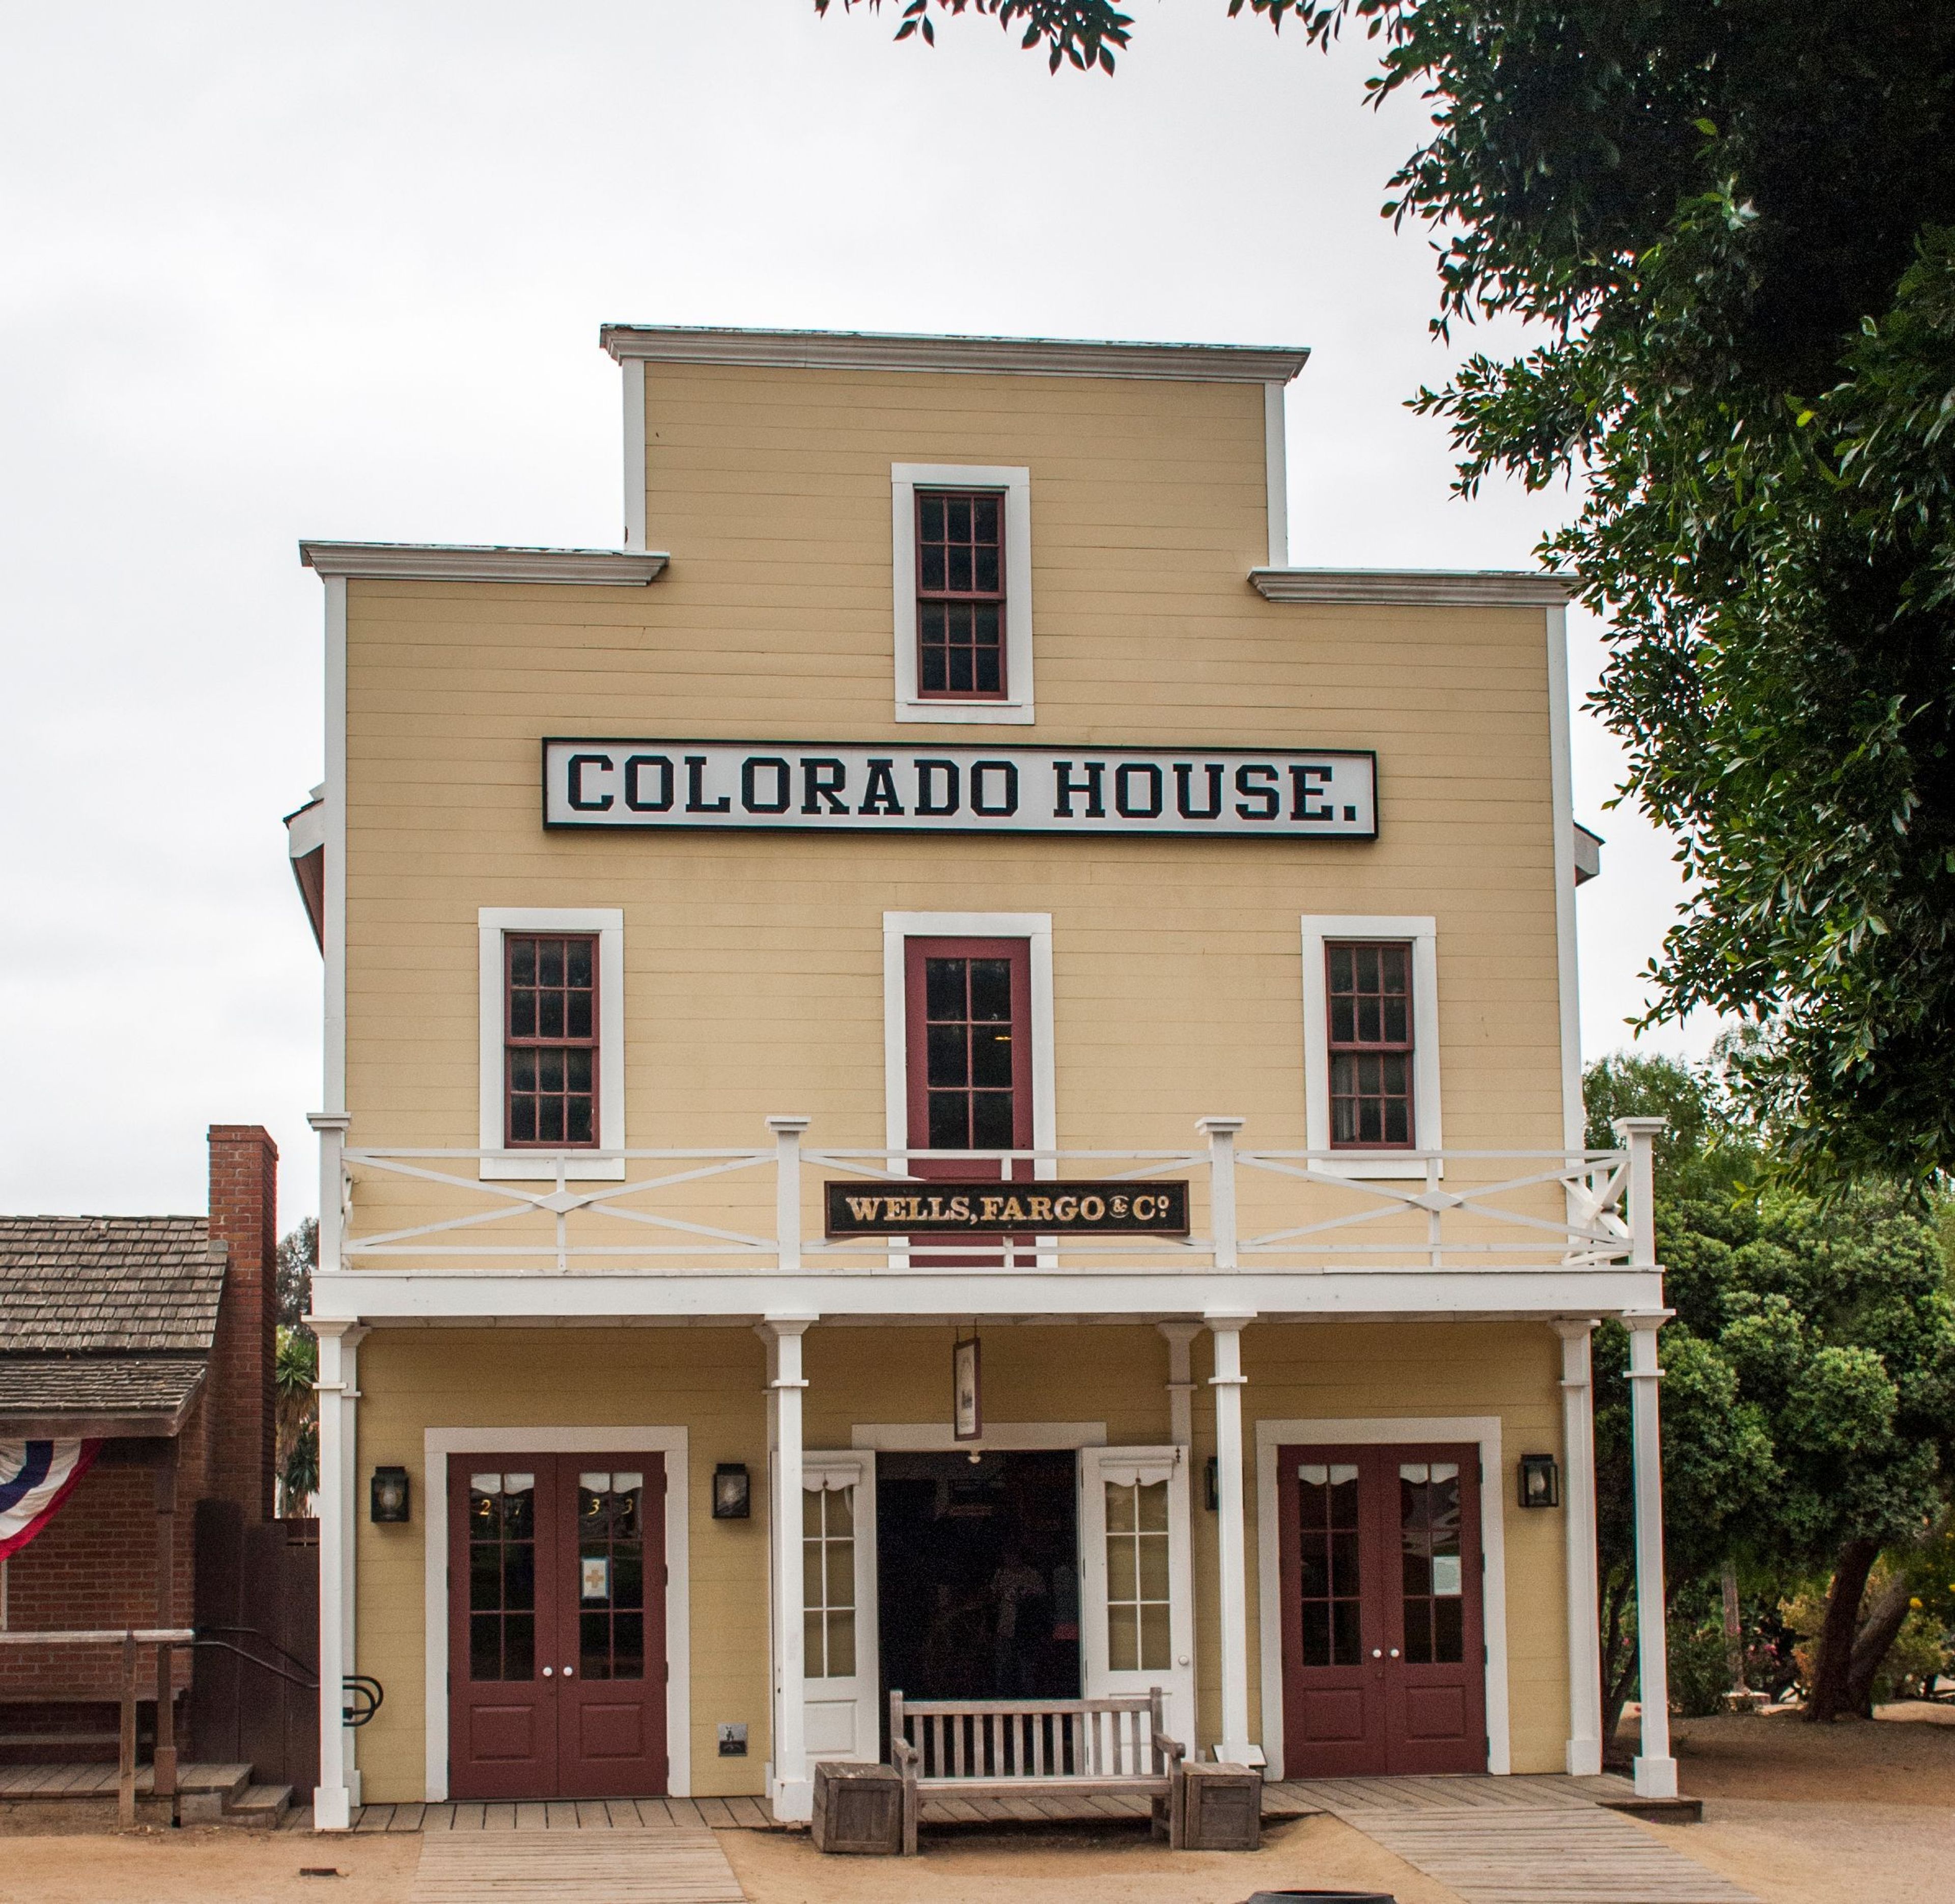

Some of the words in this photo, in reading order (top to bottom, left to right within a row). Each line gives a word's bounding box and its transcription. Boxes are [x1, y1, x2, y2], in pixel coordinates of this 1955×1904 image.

[567, 754, 1018, 817] COLORADO
[1052, 761, 1356, 822] HOUSE.
[845, 1196, 978, 1225] WELLS,
[980, 1196, 1105, 1221] FARGO
